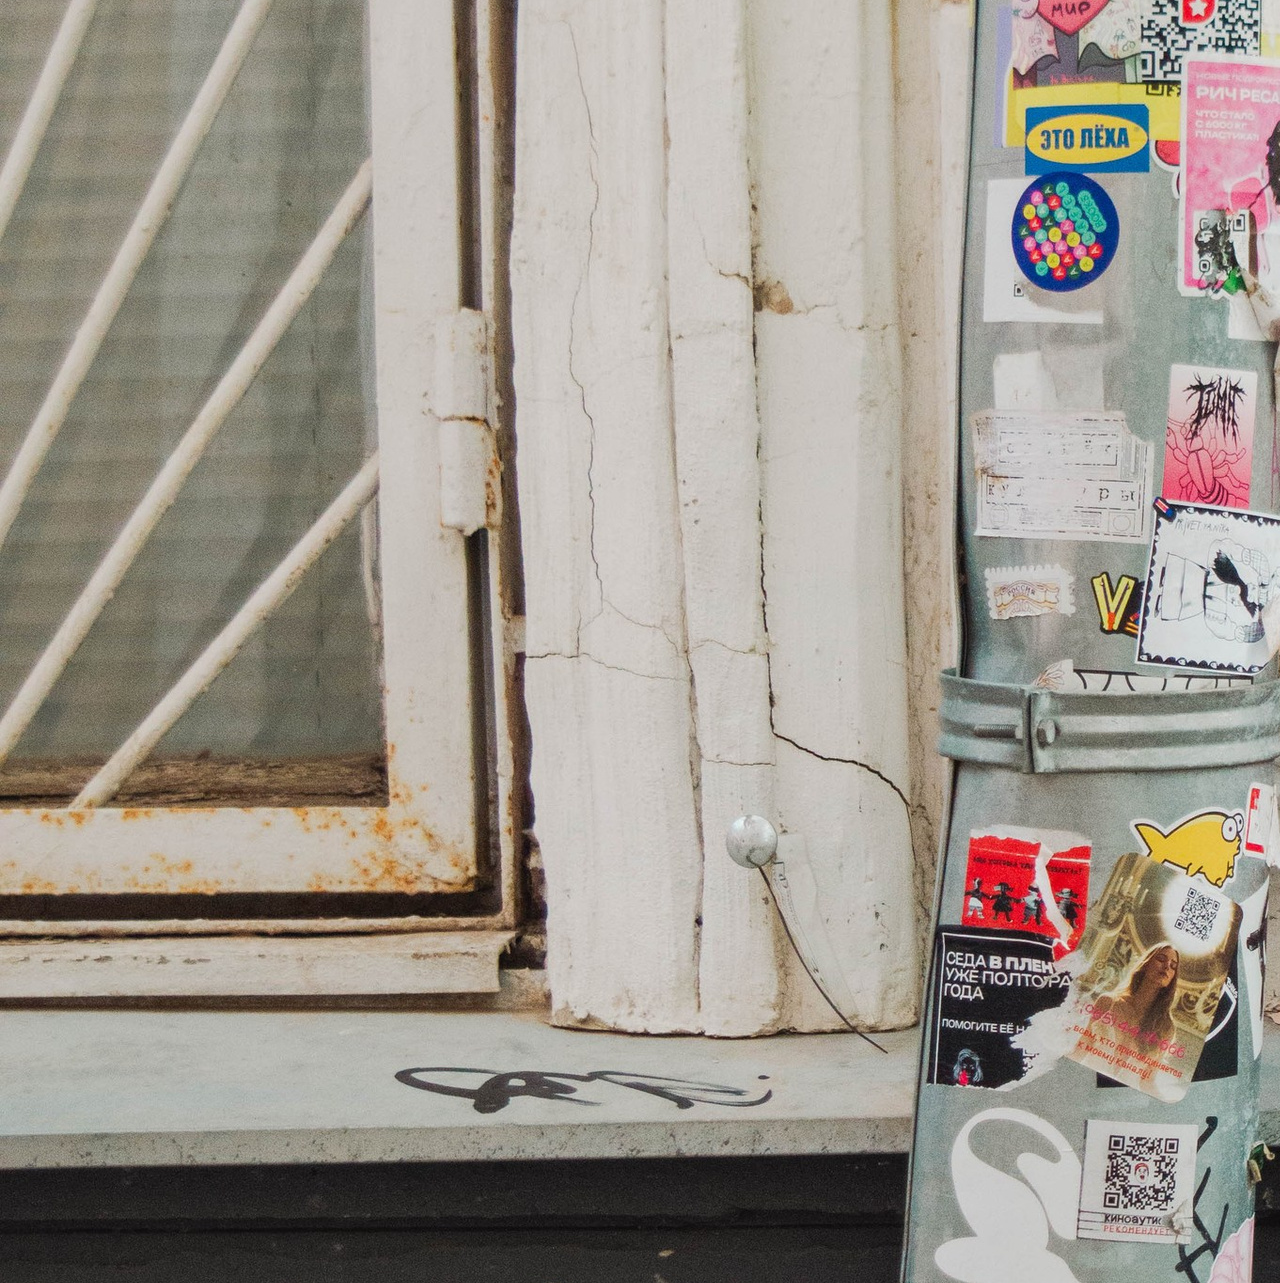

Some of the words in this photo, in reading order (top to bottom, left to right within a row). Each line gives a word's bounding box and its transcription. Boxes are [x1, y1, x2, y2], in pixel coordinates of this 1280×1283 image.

[1196, 85, 1237, 100] РИЧ
[1040, 129, 1075, 150] ЭТО
[1080, 124, 1130, 149] ЛЁХА
[946, 951, 986, 969] СЕДА
[989, 956, 1002, 970] В
[945, 967, 979, 983] УЖЕ
[982, 970, 1073, 990] ПОЛТОРА
[944, 983, 985, 1001] ГОДА
[942, 1018, 998, 1034] ПОМОГИТЕ
[999, 1021, 1015, 1034] ЕЁ
